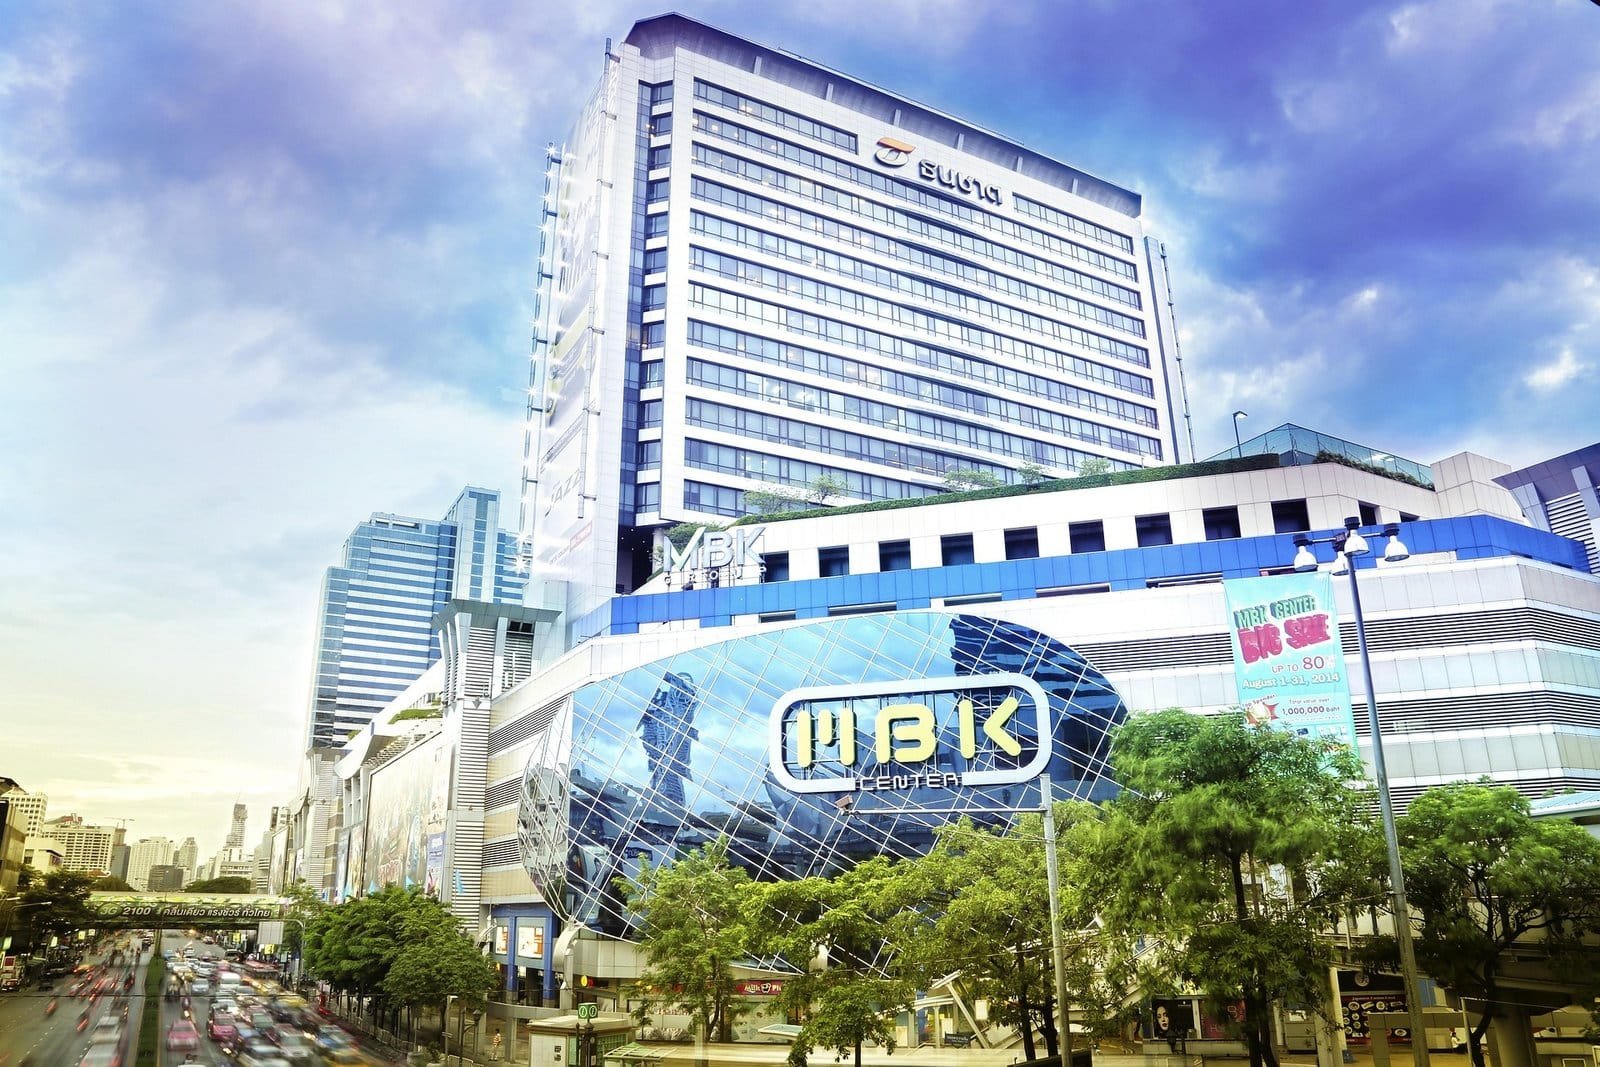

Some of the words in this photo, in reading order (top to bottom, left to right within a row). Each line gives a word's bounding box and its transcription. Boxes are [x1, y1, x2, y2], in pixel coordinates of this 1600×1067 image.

[919, 159, 1003, 206] ธนชาต
[663, 526, 767, 571] MBK
[1234, 605, 1269, 629] MBK
[1270, 595, 1316, 619] CENTER
[1271, 665, 1284, 673] UP
[1287, 664, 1299, 672] TO
[1242, 678, 1277, 690] August
[1312, 672, 1341, 685] 2014
[1282, 706, 1325, 716] 1,000,000
[797, 697, 1022, 767] MBK
[860, 773, 959, 791] CENTER
[100, 907, 118, 915] 3G
[122, 907, 151, 915] 2100
